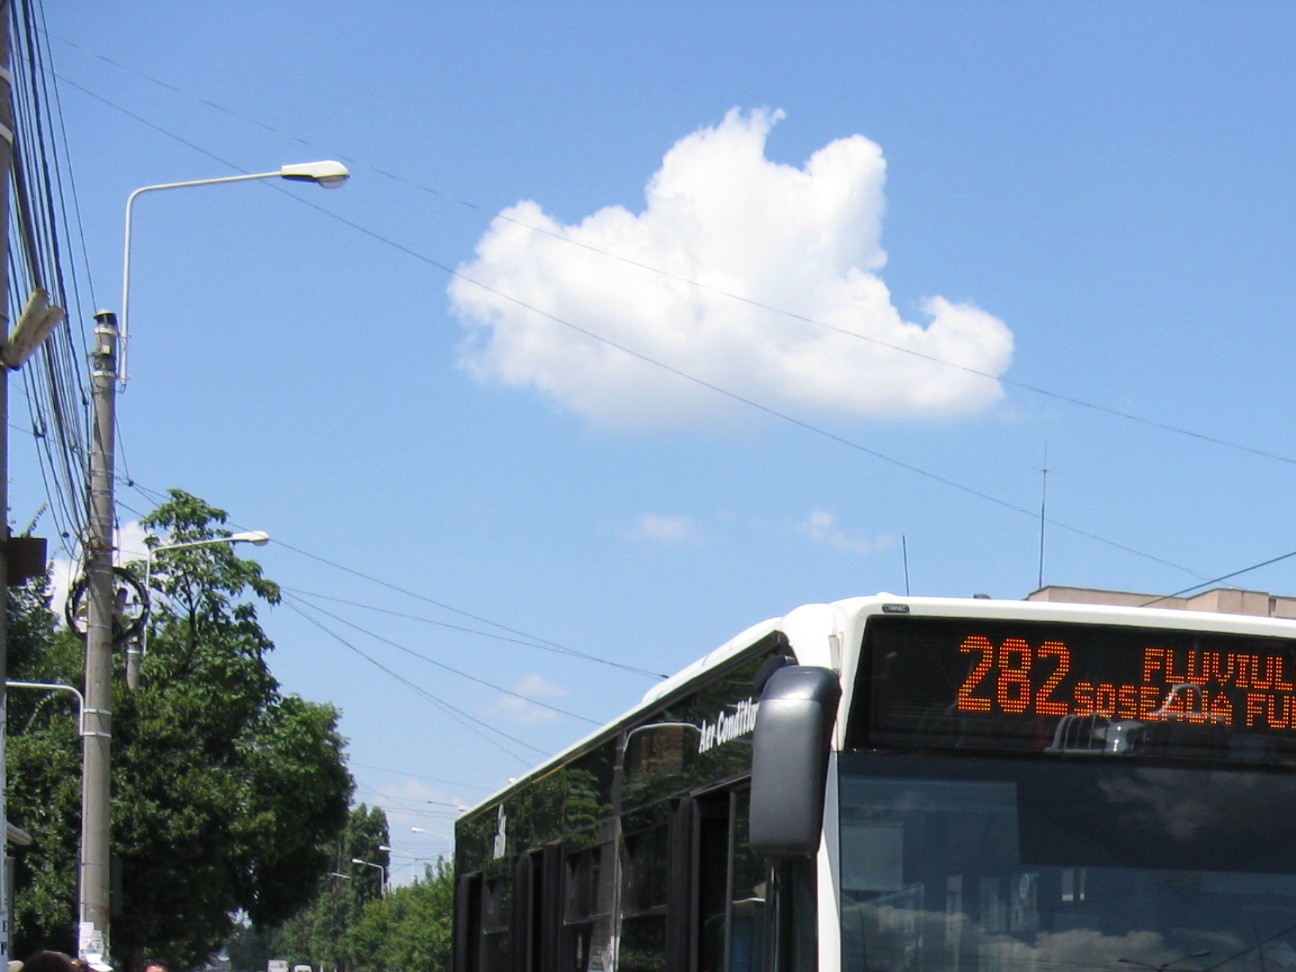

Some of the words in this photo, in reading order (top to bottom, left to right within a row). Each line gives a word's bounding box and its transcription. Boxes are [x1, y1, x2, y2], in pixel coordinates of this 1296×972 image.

[957, 635, 1071, 717] 282
[1073, 681, 1234, 726] SOSEAUA
[698, 719, 716, 754] Aer
[716, 696, 760, 746] Conditio
